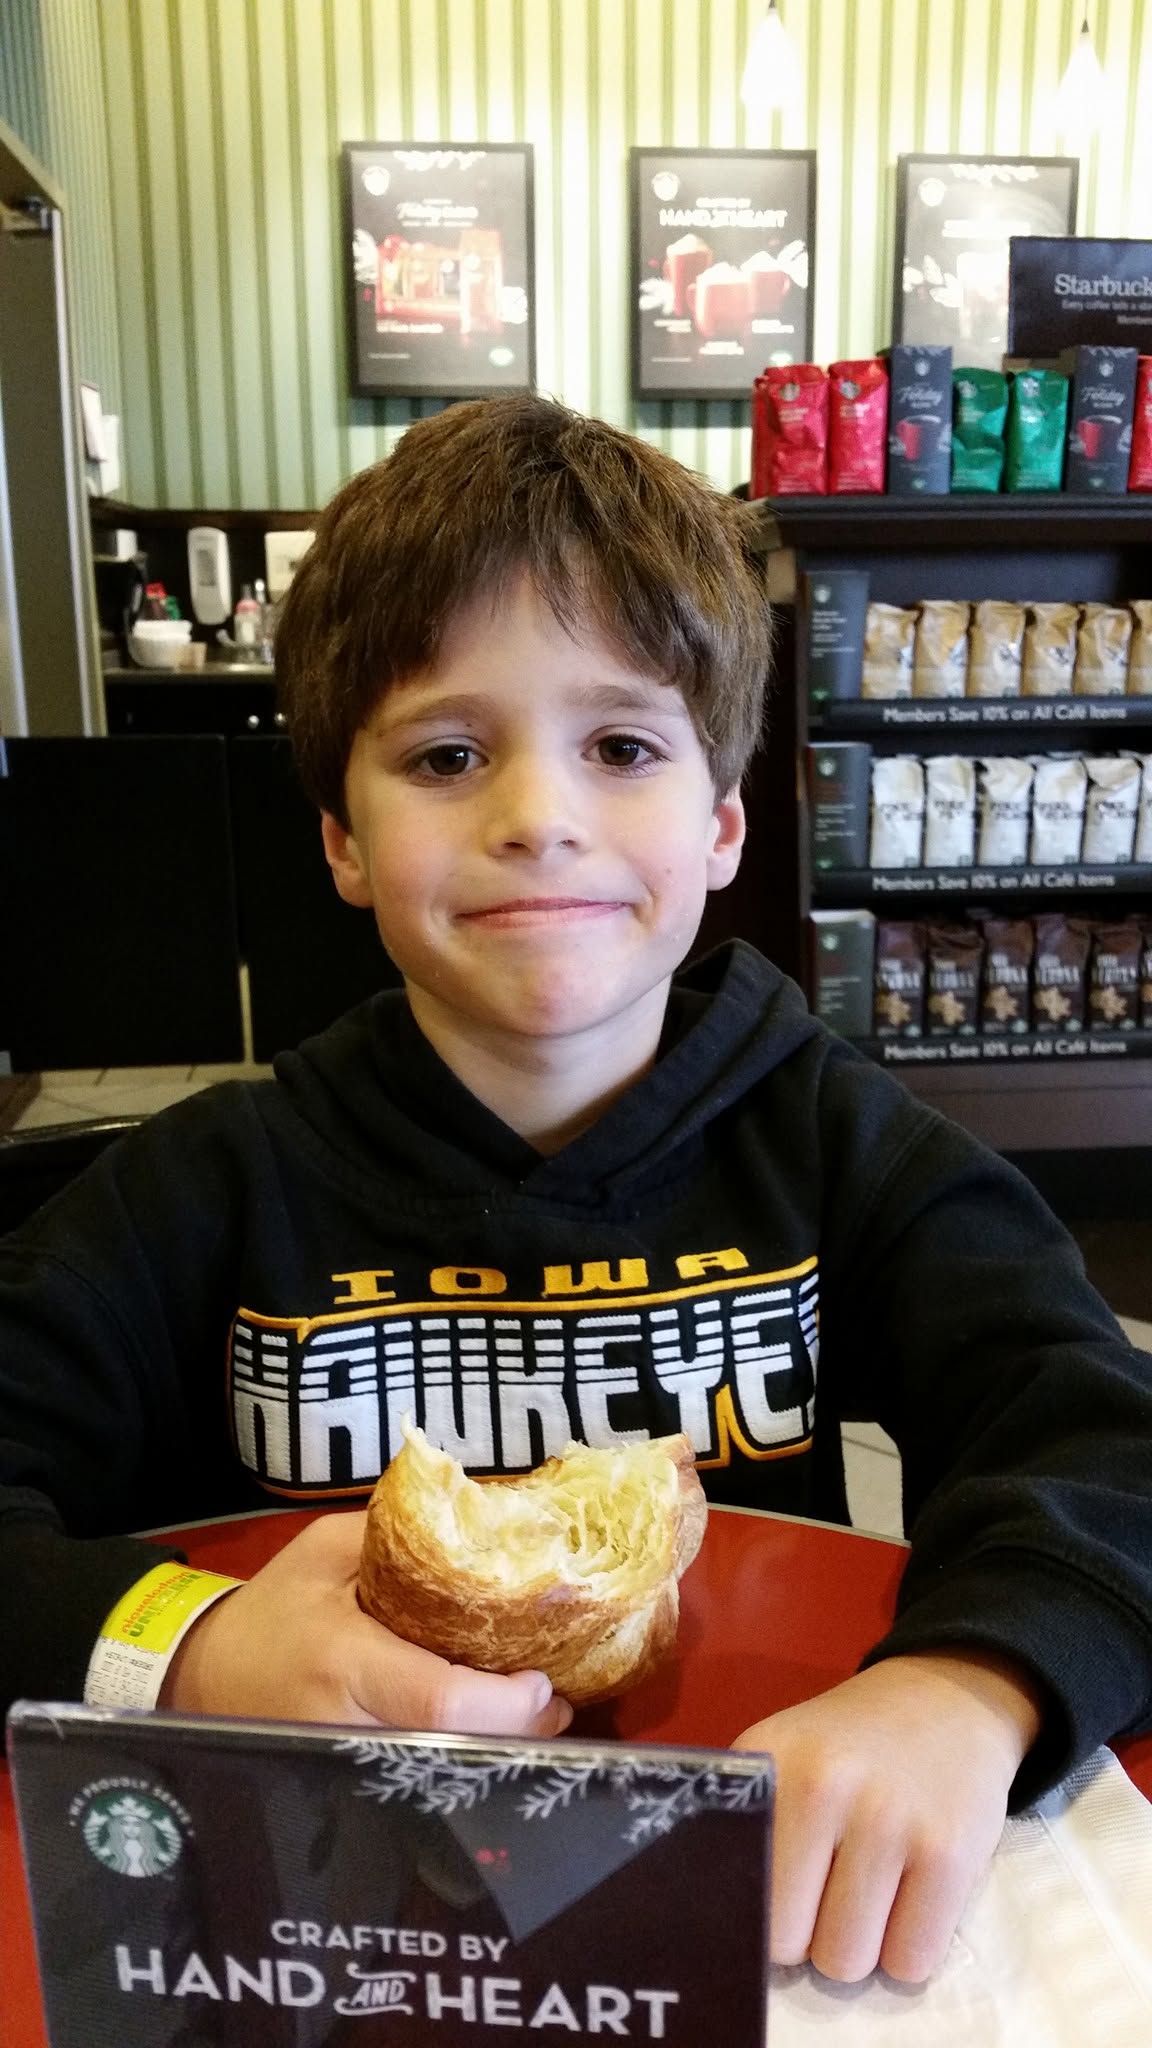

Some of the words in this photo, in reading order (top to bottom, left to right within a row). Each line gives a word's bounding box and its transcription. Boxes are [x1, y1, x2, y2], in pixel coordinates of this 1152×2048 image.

[883, 708, 946, 722] Members
[949, 706, 979, 721] Save
[982, 706, 1009, 720] 10%
[1010, 709, 1030, 720] on
[1033, 705, 1052, 719] All
[1090, 705, 1127, 719] Items
[872, 875, 935, 890] Members
[938, 874, 968, 889] Save
[971, 874, 996, 888] 10%
[1000, 877, 1018, 888] on
[1021, 873, 1041, 888] All
[884, 1043, 946, 1060] Members
[950, 1042, 980, 1058] Save
[983, 1040, 1009, 1056] 10%
[1011, 1044, 1030, 1056] on
[1033, 1040, 1052, 1055] All
[332, 1247, 748, 1304] IOWA
[69, 1797, 85, 1816] WE
[82, 1777, 149, 1798] PROUDLY
[152, 1787, 191, 1824] SERVE
[271, 1919, 447, 1957] CRAFTED
[460, 1936, 510, 1962] BY
[115, 1945, 326, 2008] HAND
[350, 1978, 407, 2008] AND
[425, 1972, 680, 2038] HEART
